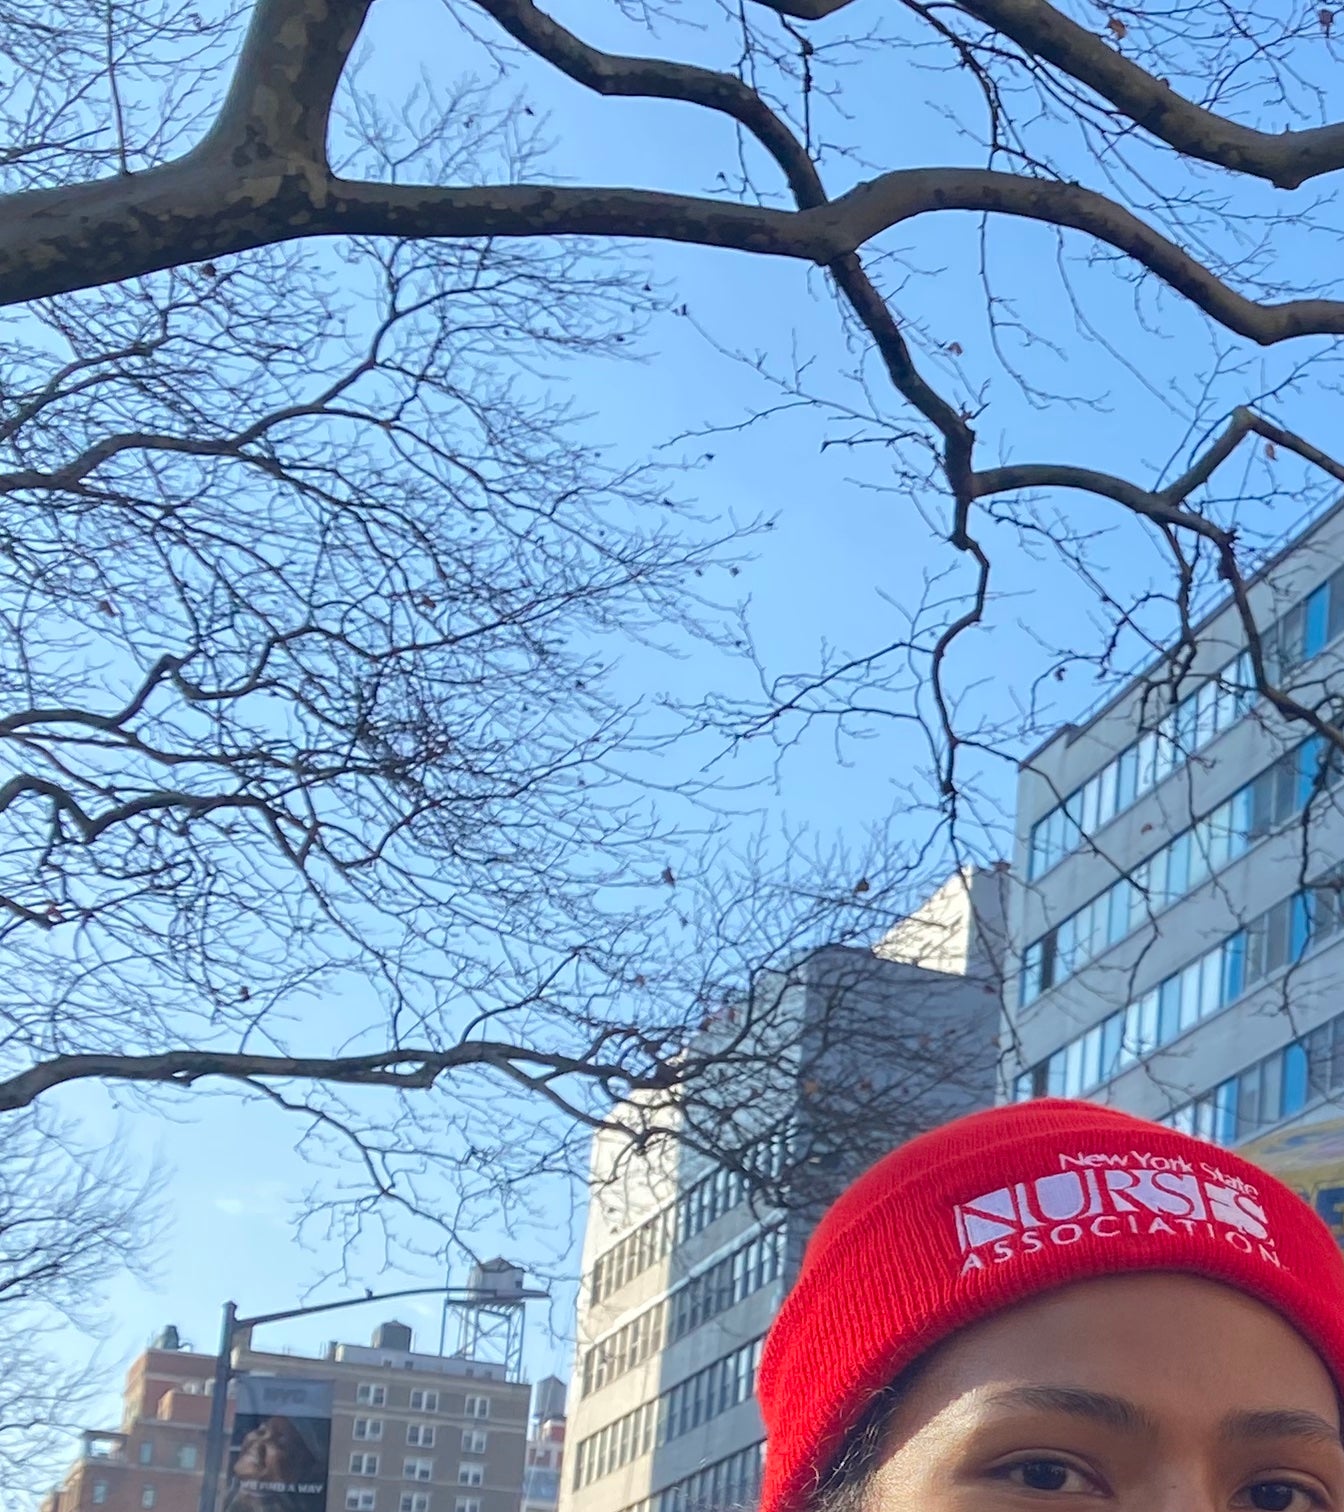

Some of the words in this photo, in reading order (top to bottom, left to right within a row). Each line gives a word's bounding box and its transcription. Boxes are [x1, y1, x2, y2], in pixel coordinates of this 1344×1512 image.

[1059, 1150, 1129, 1170] New
[1130, 1150, 1194, 1172] York
[953, 1167, 1269, 1255] NURSES
[960, 1214, 1282, 1277] ASSOCIATION
